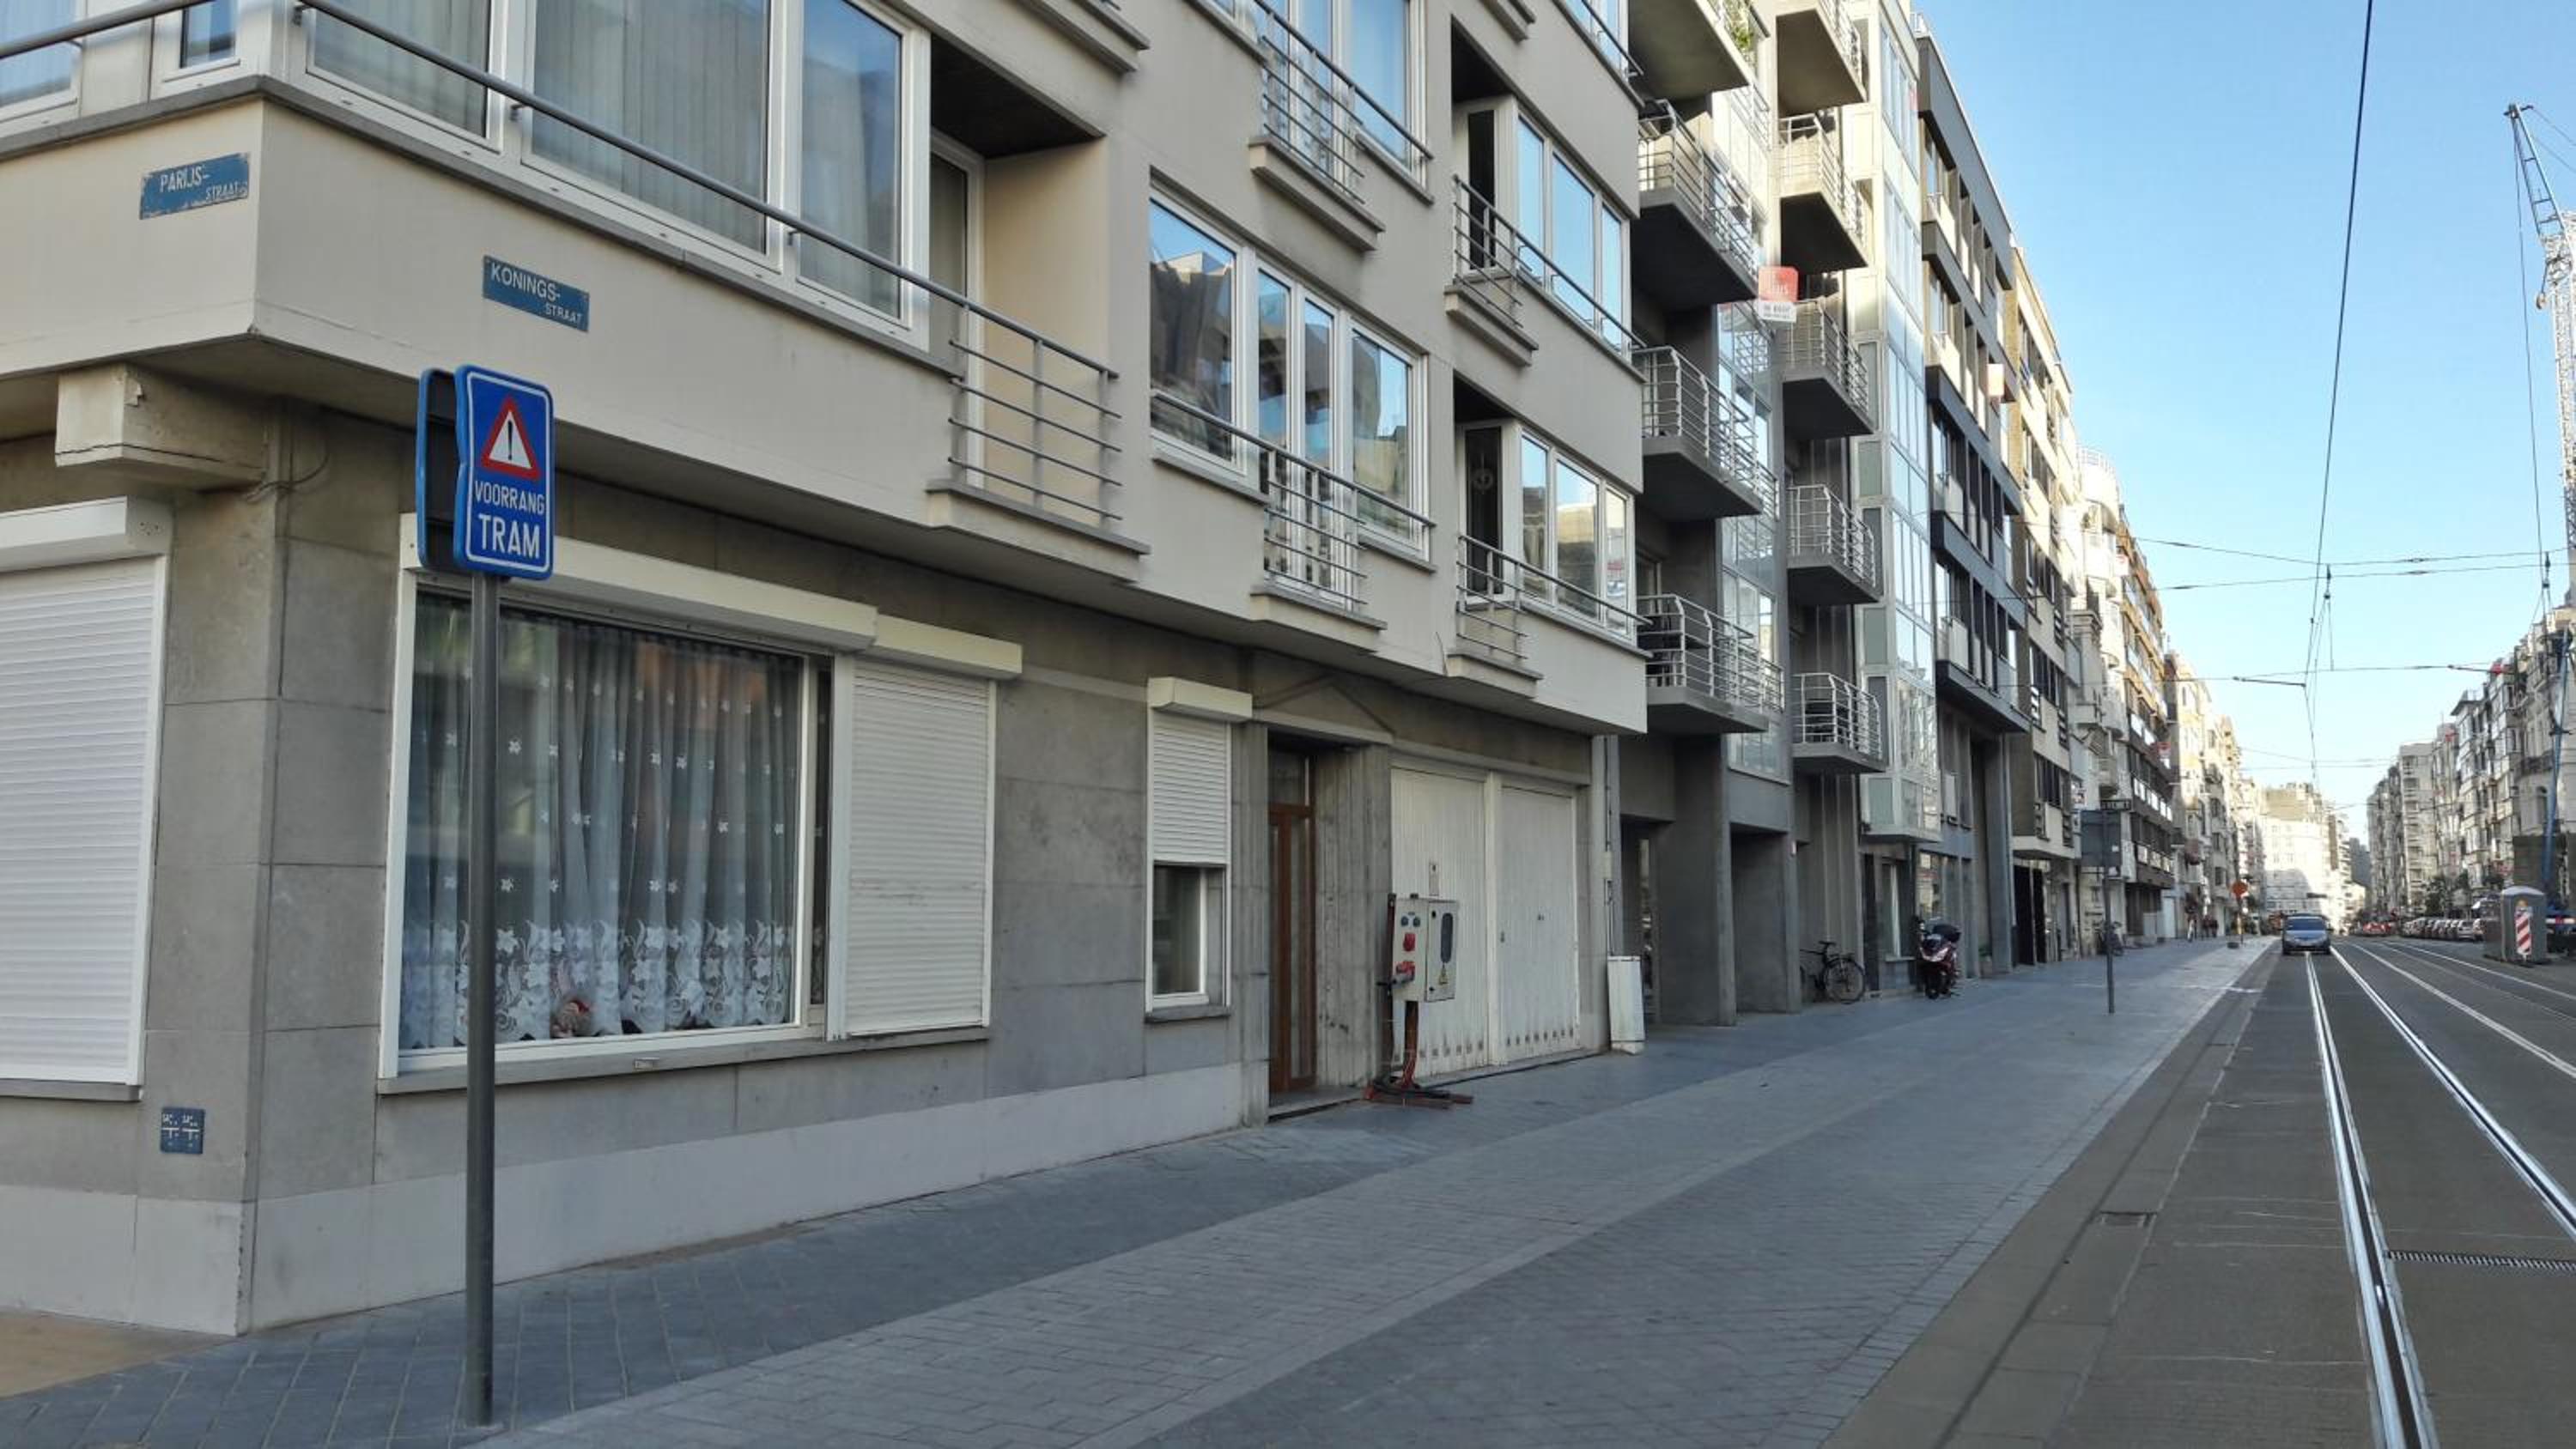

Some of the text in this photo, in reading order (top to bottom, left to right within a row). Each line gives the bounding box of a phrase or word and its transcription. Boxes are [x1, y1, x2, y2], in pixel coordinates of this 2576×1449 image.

[205, 181, 238, 202] STRAAT
[490, 262, 561, 302] KONINGS-
[544, 303, 583, 324] STRAAT
[475, 480, 545, 515] VOORRANG
[478, 513, 540, 559] TRAM
